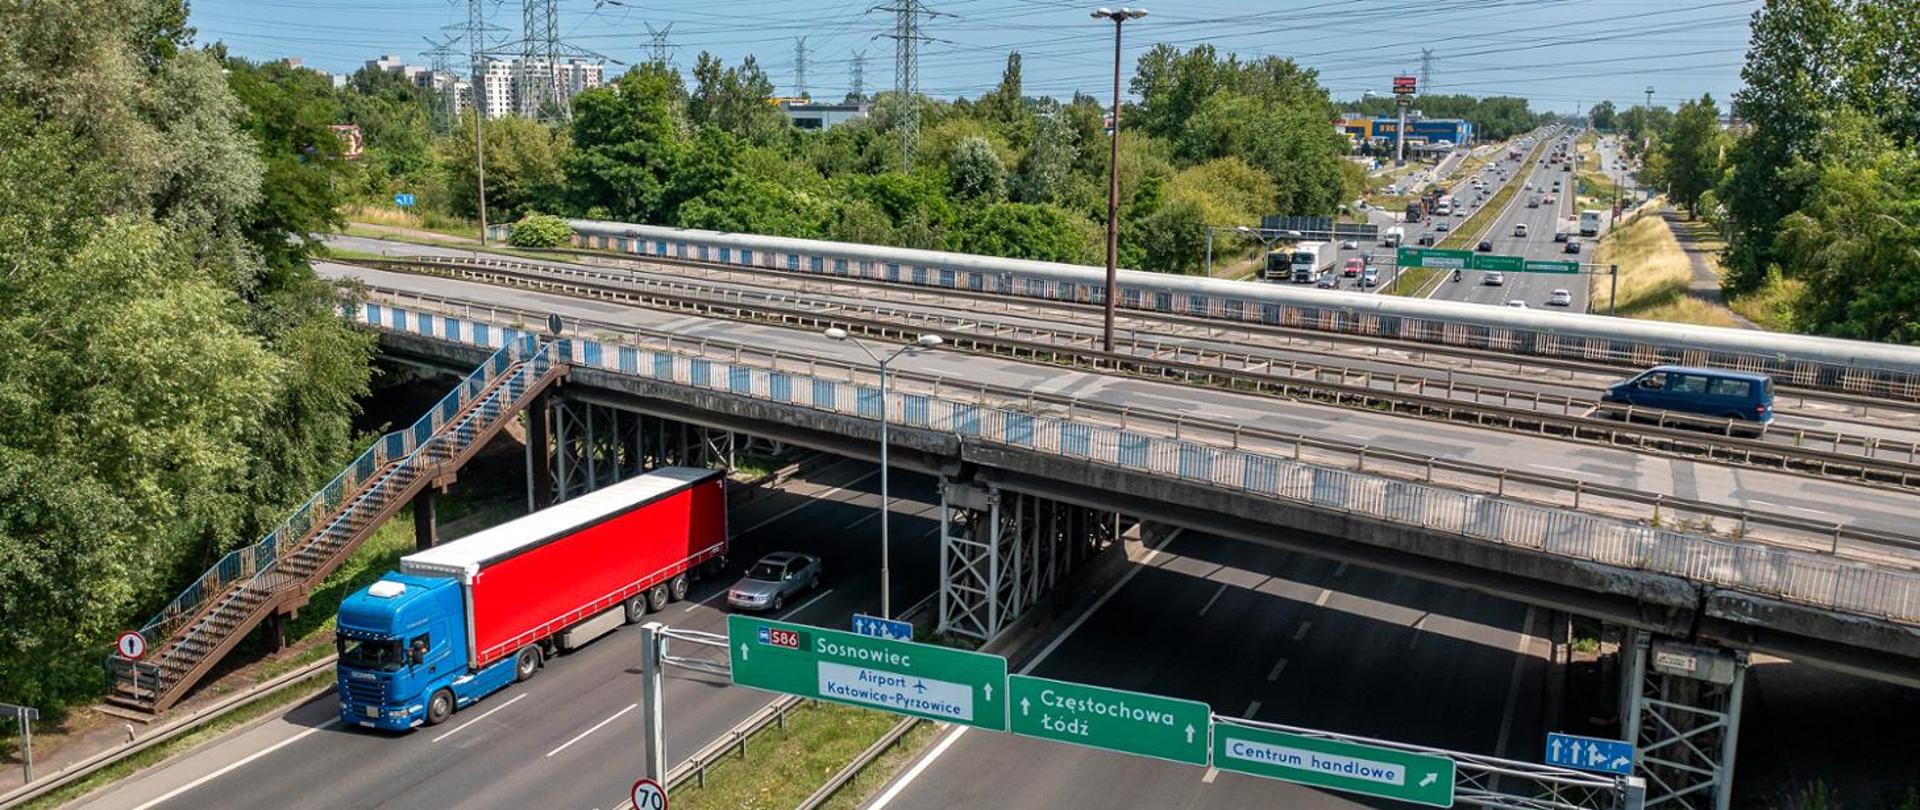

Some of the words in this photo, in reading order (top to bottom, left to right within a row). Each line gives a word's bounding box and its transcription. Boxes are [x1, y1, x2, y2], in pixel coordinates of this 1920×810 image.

[1379, 124, 1414, 132] IKA
[772, 631, 798, 647] S86
[817, 638, 911, 667] Sosnowiec
[859, 669, 906, 688] Airport
[827, 682, 961, 715] Katowice-Pyrzowice
[1041, 690, 1174, 726] Częstochowa
[1041, 713, 1089, 736] Łódź
[1233, 742, 1302, 766] Centrum
[1312, 756, 1395, 782] handlowe
[639, 788, 662, 810] 70
